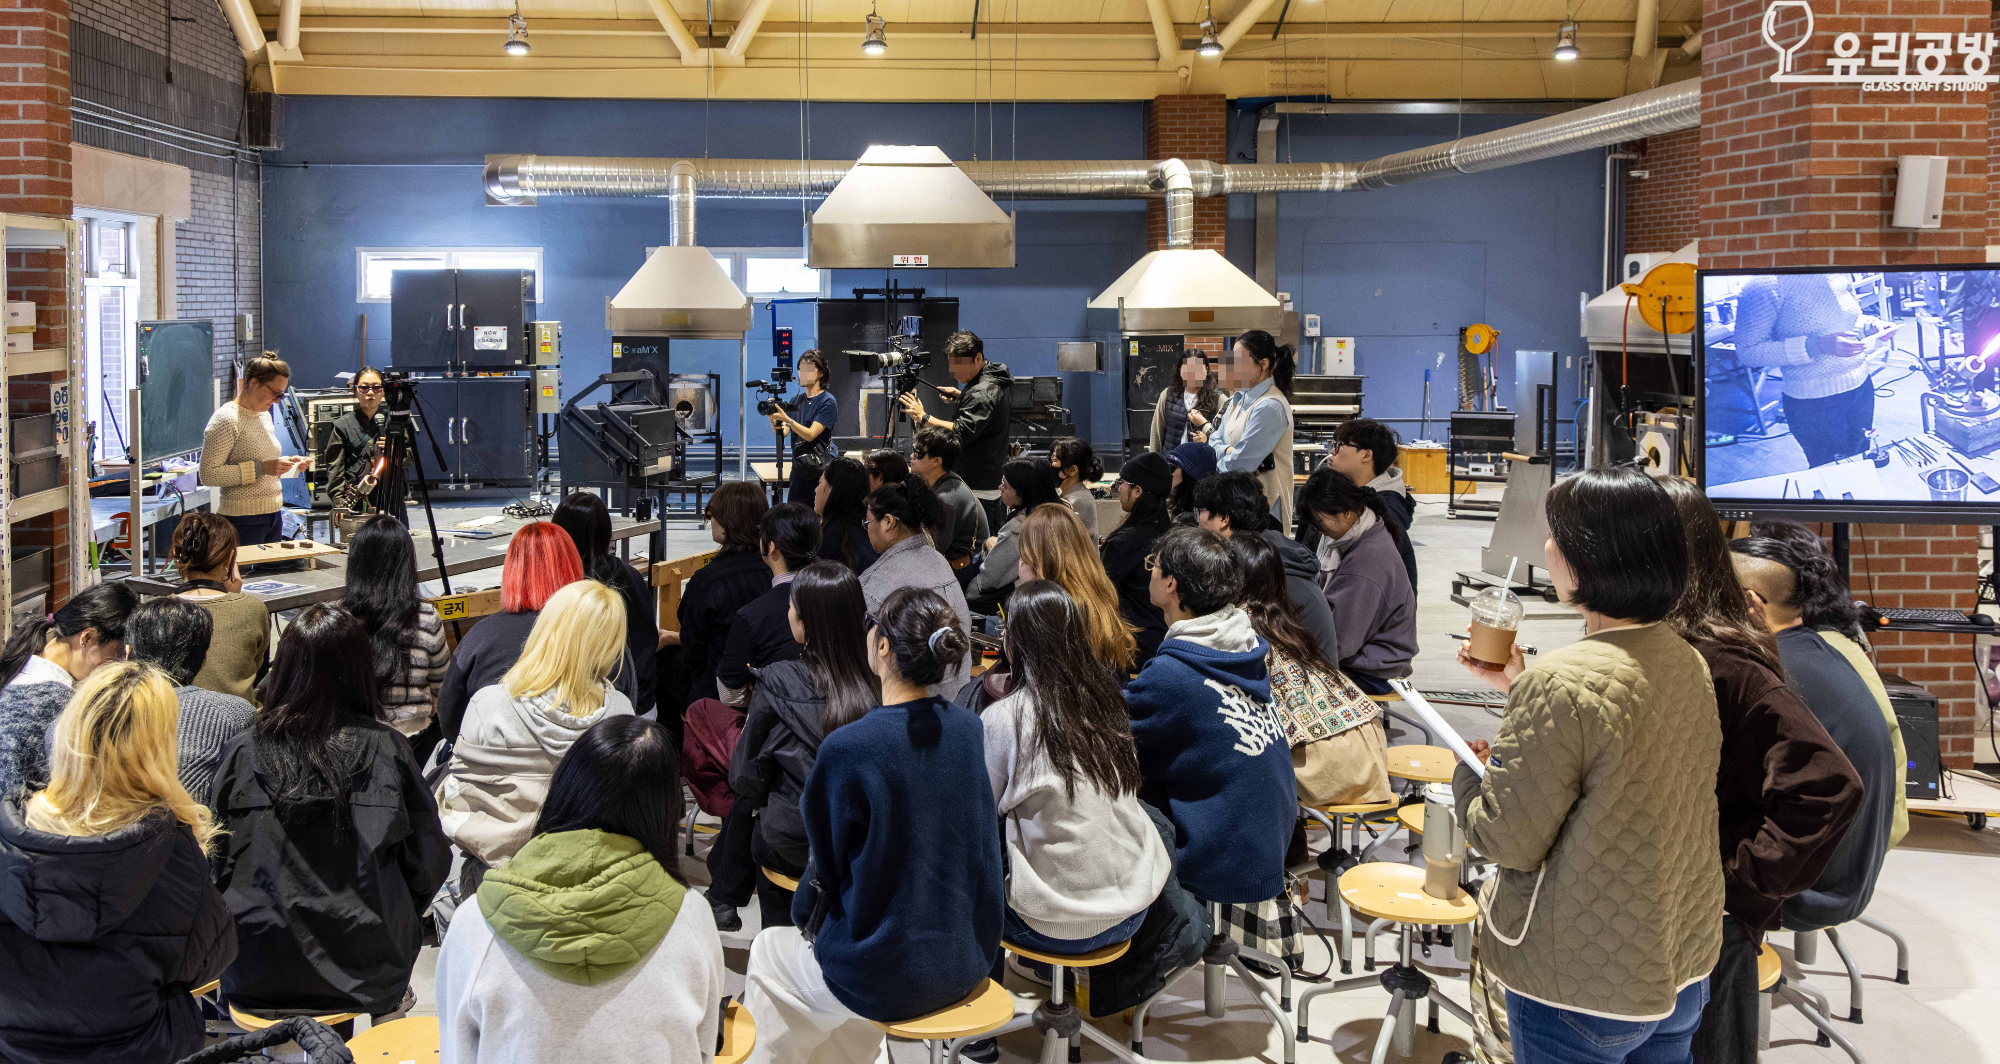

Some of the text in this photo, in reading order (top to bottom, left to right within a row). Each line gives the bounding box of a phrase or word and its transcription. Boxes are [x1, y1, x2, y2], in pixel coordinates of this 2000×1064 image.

[1826, 32, 1999, 77] 유리공방
[1862, 81, 1988, 93] GLASS CRAFT STUDIO
[443, 601, 465, 616] 금지
